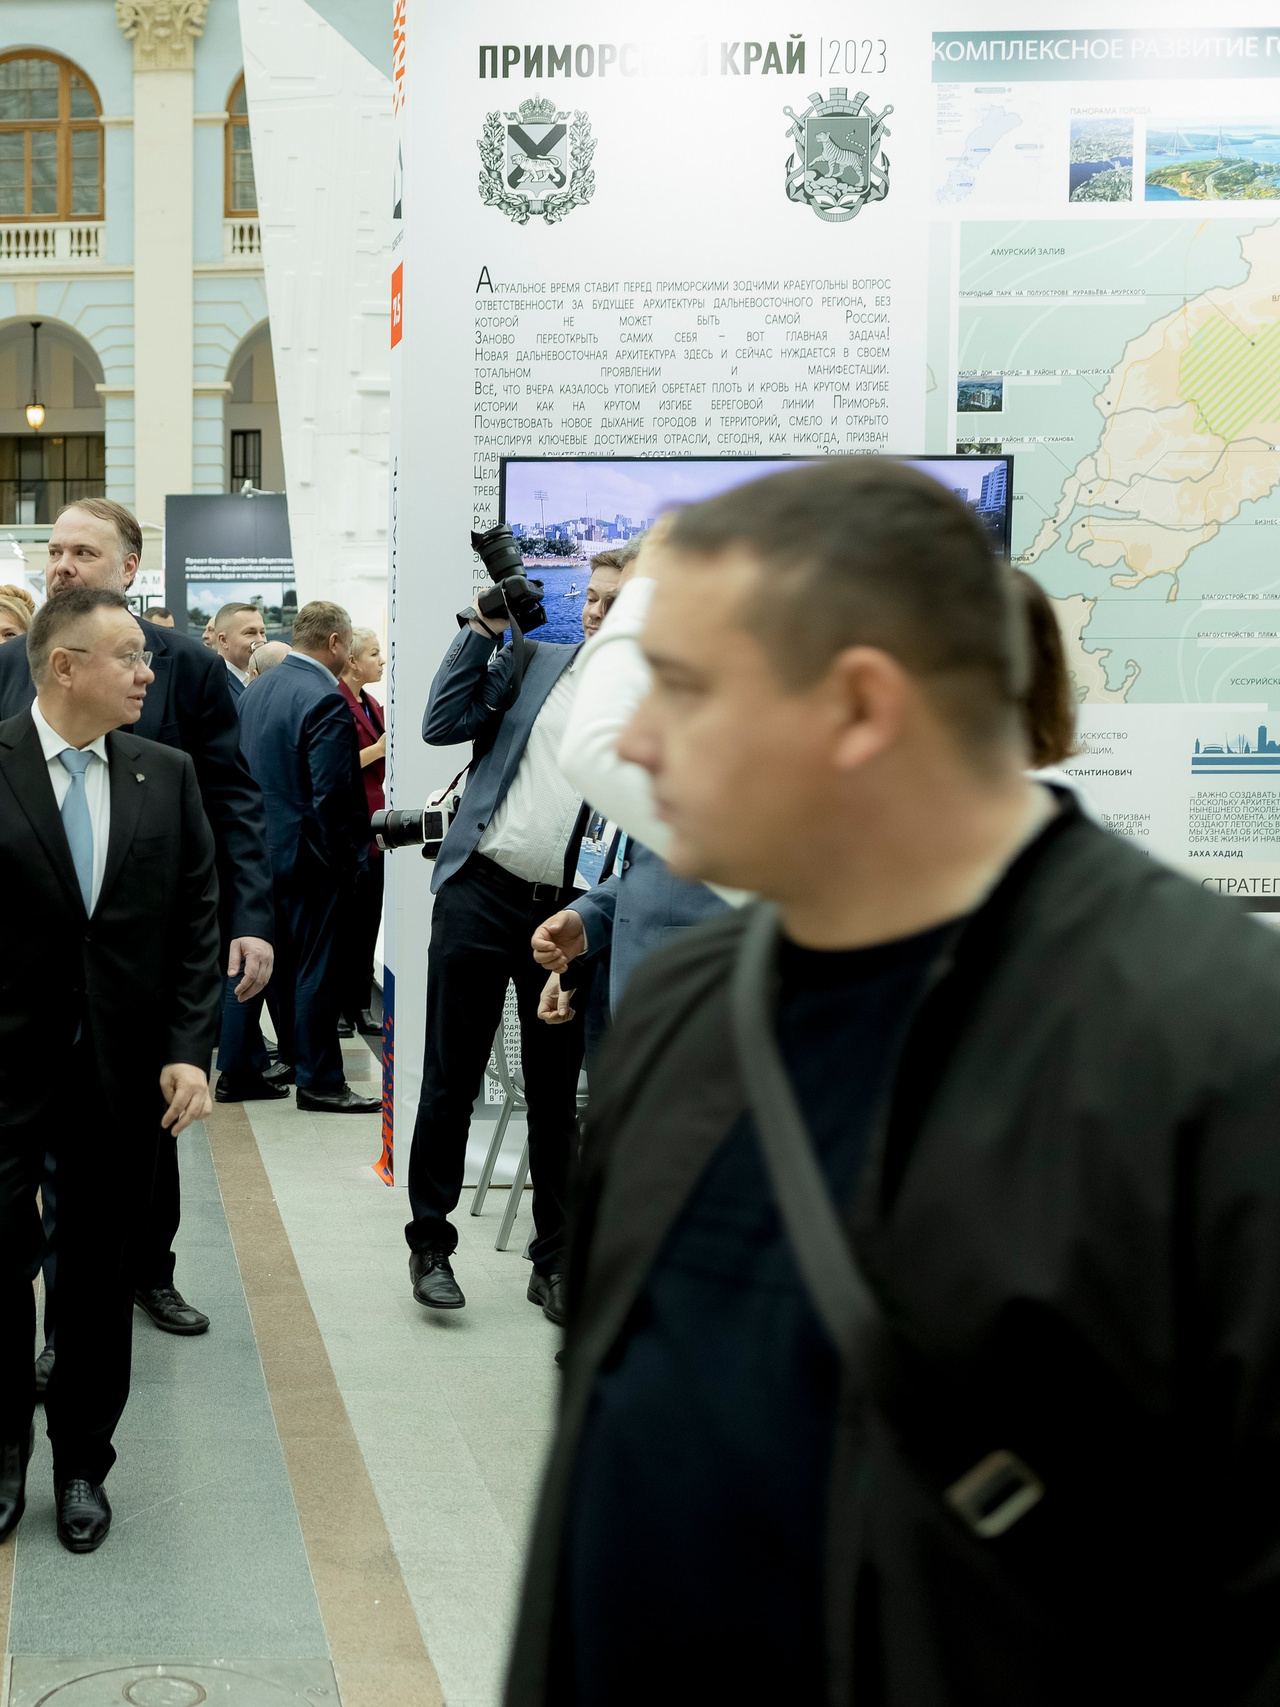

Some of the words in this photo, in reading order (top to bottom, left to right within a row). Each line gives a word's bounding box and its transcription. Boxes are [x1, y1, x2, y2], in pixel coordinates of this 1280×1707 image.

[478, 36, 709, 79] ПРИМОРСЙ
[720, 33, 807, 76] КРАЙ
[932, 38, 1123, 62] КОМПЛЕКСНОЕ
[1131, 36, 1259, 59] РАЗВИТИЕ
[1070, 107, 1117, 115] ПАНОРАМА
[991, 247, 1036, 255] АМУРСКИЙ
[476, 266, 546, 293] АКТУАЛЬНОЕ
[551, 283, 579, 293] ВРЕМЯ
[585, 282, 619, 292] СТАВИТ
[624, 282, 652, 293] ПЕРЕД
[657, 281, 728, 291] ПРИМОРСКИМИ
[734, 281, 779, 291] ЗОДЧИМИ
[853, 279, 891, 289] ВОПРОС
[475, 300, 563, 310] ОТВЕТСТВЕННОСТИ
[572, 300, 583, 309] ЗА
[593, 299, 634, 310] БУДУЩЕЕ
[643, 298, 704, 309] АРХИТЕКТУРЫ
[714, 297, 813, 309] ДАЛЬНЕВОСТОЧНОГО
[876, 296, 890, 306] БЕЗ
[475, 315, 518, 327] КОТОРОЙ
[564, 317, 574, 326] НЕ
[620, 316, 652, 326] МОЖЕТ
[697, 315, 720, 325] БЫТЬ
[765, 312, 800, 324] САМОЙ
[475, 331, 515, 344] ЗАНОВО
[537, 333, 598, 344] ПЕРЕОТКРЫТЬ
[620, 333, 653, 343] САМИХ
[675, 332, 697, 342] СЕБЯ
[747, 331, 764, 341] ВОТ
[786, 331, 827, 341] ГЛАВНАЯ
[475, 348, 508, 361] НОВАЯ
[516, 350, 607, 362] ДАЛЬНЕВОСТОЧНАЯ
[615, 350, 676, 360] АРХИТЕКТУРА
[684, 349, 713, 360] ЗДЕСЬ
[721, 349, 727, 358] И
[736, 347, 772, 359] СЕЙЧАС
[781, 348, 835, 359] НУЖДАЕТСЯ
[844, 348, 849, 357] В
[857, 347, 889, 357] СВОЁМ
[475, 368, 531, 378] ТОТАЛЬНОМ
[601, 367, 661, 377] ПРОЯВЛЕНИИ
[732, 366, 737, 375] И
[503, 385, 520, 395] ЧТО
[527, 384, 554, 394] ВЧЕРА
[560, 384, 608, 394] КАЗАЛОСЬ
[615, 382, 656, 394] УТОПИЕЙ
[662, 383, 706, 393] ОБРЕТАЕТ
[712, 383, 742, 393] ПЛОТЬ
[748, 383, 754, 392] И
[761, 382, 789, 392] КРОВЬ
[795, 382, 808, 392] НА
[814, 382, 849, 391] КРУТОМ
[856, 381, 888, 391] ИЗГИБЕ
[475, 402, 517, 412] ИСТОРИИ
[537, 402, 554, 411] КАК
[573, 401, 585, 411] НА
[604, 401, 640, 411] КРУТОМ
[659, 400, 691, 410] ИЗГИБЕ
[712, 397, 762, 410] БЕРЕГОВОЙ
[782, 399, 814, 409] ЛИНИИ
[475, 415, 553, 428] ПОЧУВСТВОВАТЬ
[562, 418, 592, 428] НОВОЕ
[601, 417, 644, 429] ДЫХАНИЕ
[653, 417, 696, 428] ГОРОДОВ
[705, 417, 711, 426] И
[789, 416, 822, 426] СМЕЛО
[831, 416, 837, 425] И
[846, 415, 888, 425] ОТКРЫТО
[474, 435, 531, 445] ТРАНСЛИРУЯ
[539, 435, 587, 445] КЛЮЧЕВЫЕ
[594, 434, 657, 446] ДОСТИЖЕНИЯ
[769, 433, 786, 443] КАК
[847, 432, 888, 442] ПРИЗВАН
[473, 503, 491, 512] КАК
[1080, 732, 1128, 740] ИСКУССТВО
[1197, 791, 1228, 799] ВАЖНО
[1230, 791, 1277, 799] СОЗДАВАТЬ
[1213, 850, 1243, 858] ХАДИД
